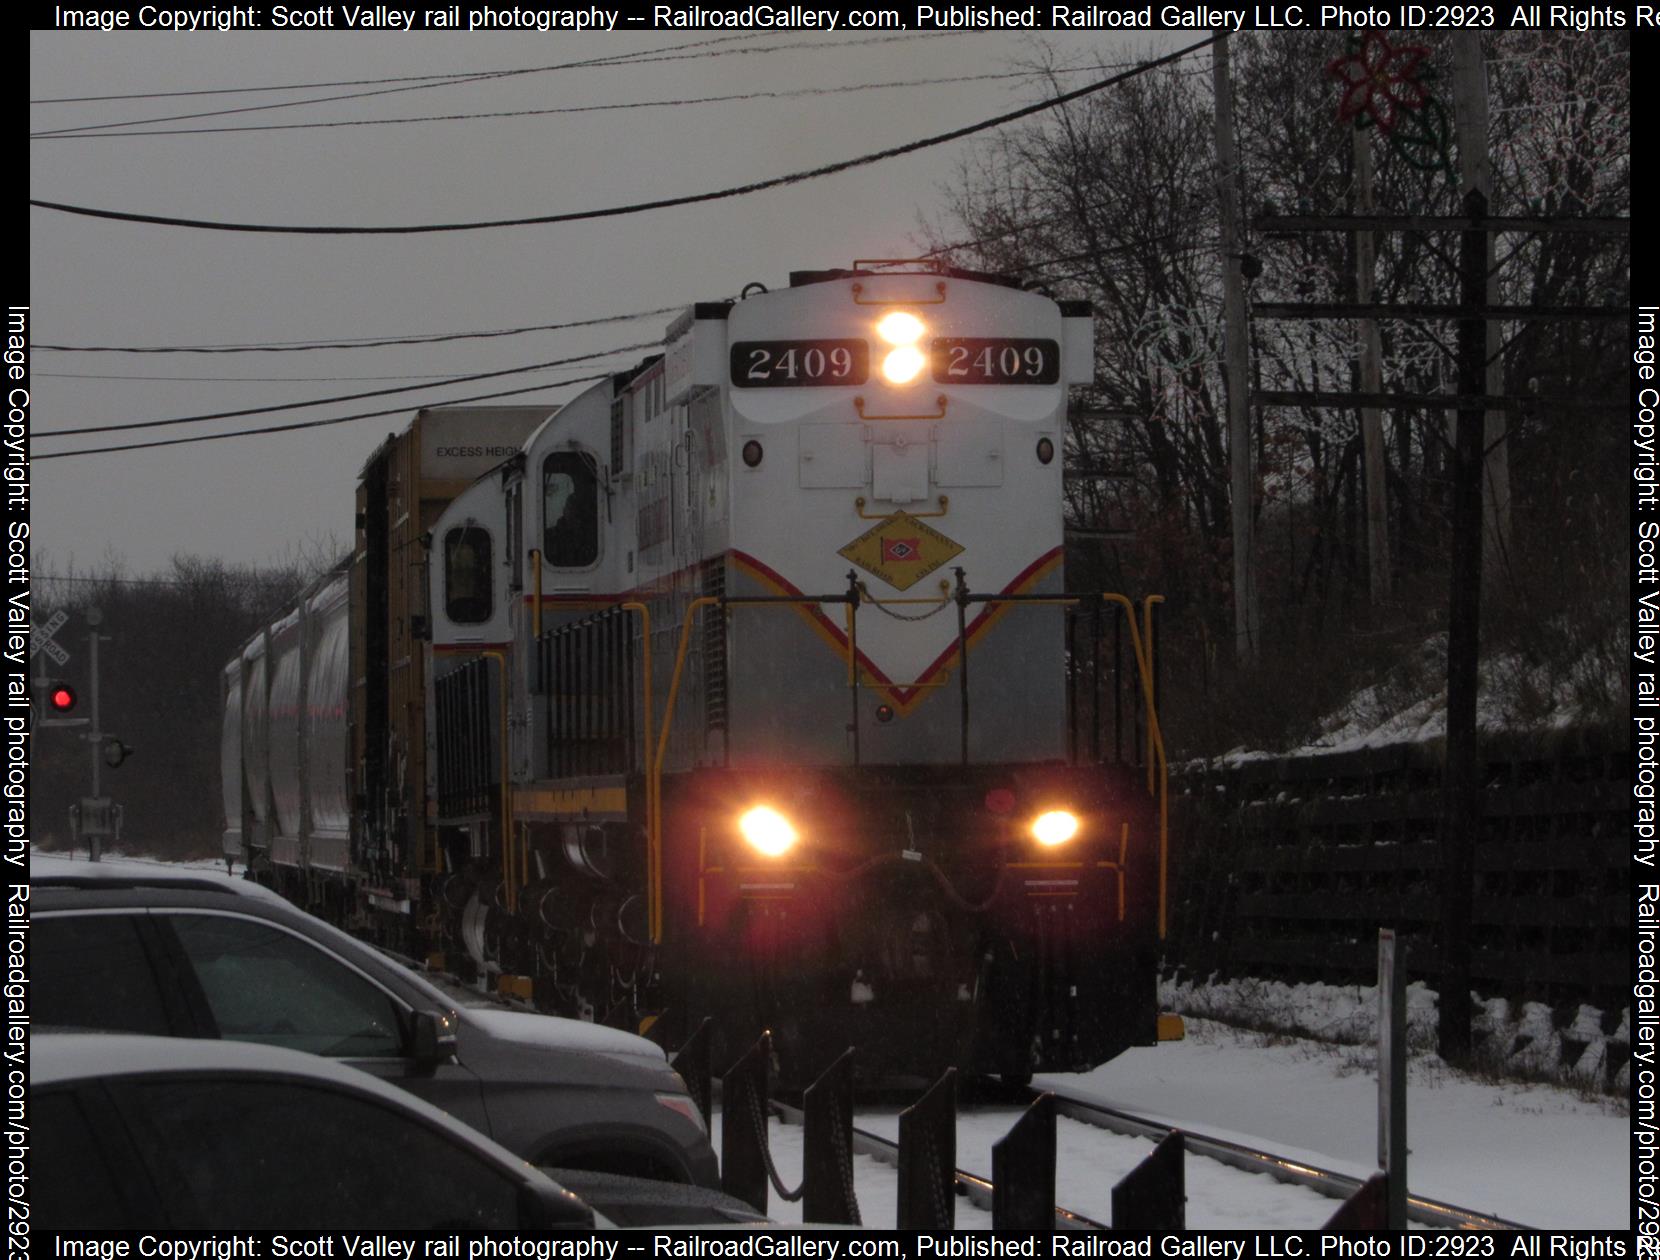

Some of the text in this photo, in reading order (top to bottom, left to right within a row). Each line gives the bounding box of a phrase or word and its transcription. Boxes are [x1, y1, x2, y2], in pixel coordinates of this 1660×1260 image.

[747, 347, 852, 379] 2409
[947, 346, 1044, 377] 2409
[437, 446, 482, 457] EXCESS
[41, 639, 66, 662] ROAD
